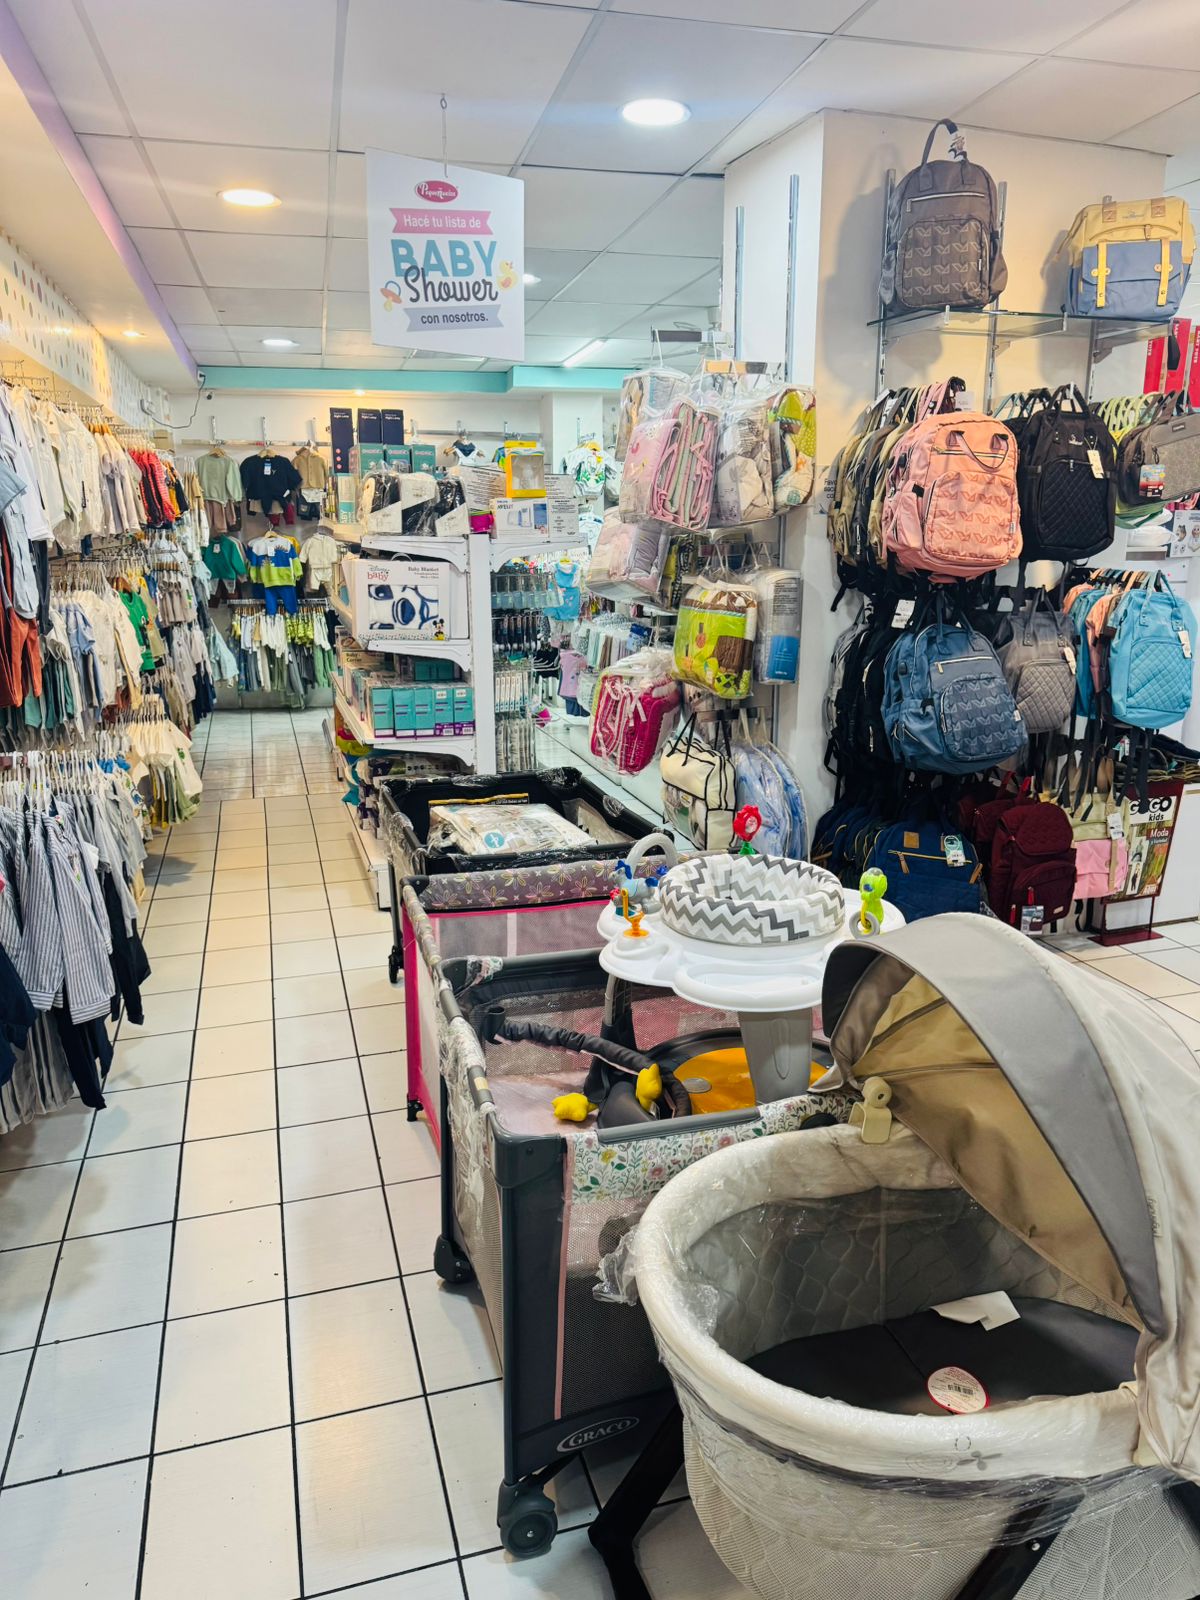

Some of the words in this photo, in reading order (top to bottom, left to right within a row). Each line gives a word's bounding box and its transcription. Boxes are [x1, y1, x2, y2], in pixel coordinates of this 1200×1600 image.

[403, 214, 430, 227] Hacé
[432, 216, 443, 227] tu
[445, 216, 466, 228] lista
[469, 217, 481, 228] de
[391, 239, 497, 277] BABY
[404, 265, 498, 303] Shower
[421, 314, 440, 324] con
[442, 311, 489, 324] nosotros.
[367, 572, 389, 582] baby
[1129, 796, 1172, 815] GGO
[1148, 813, 1165, 822] kids
[1150, 828, 1169, 838] Moda
[568, 1419, 631, 1447] GRACO
